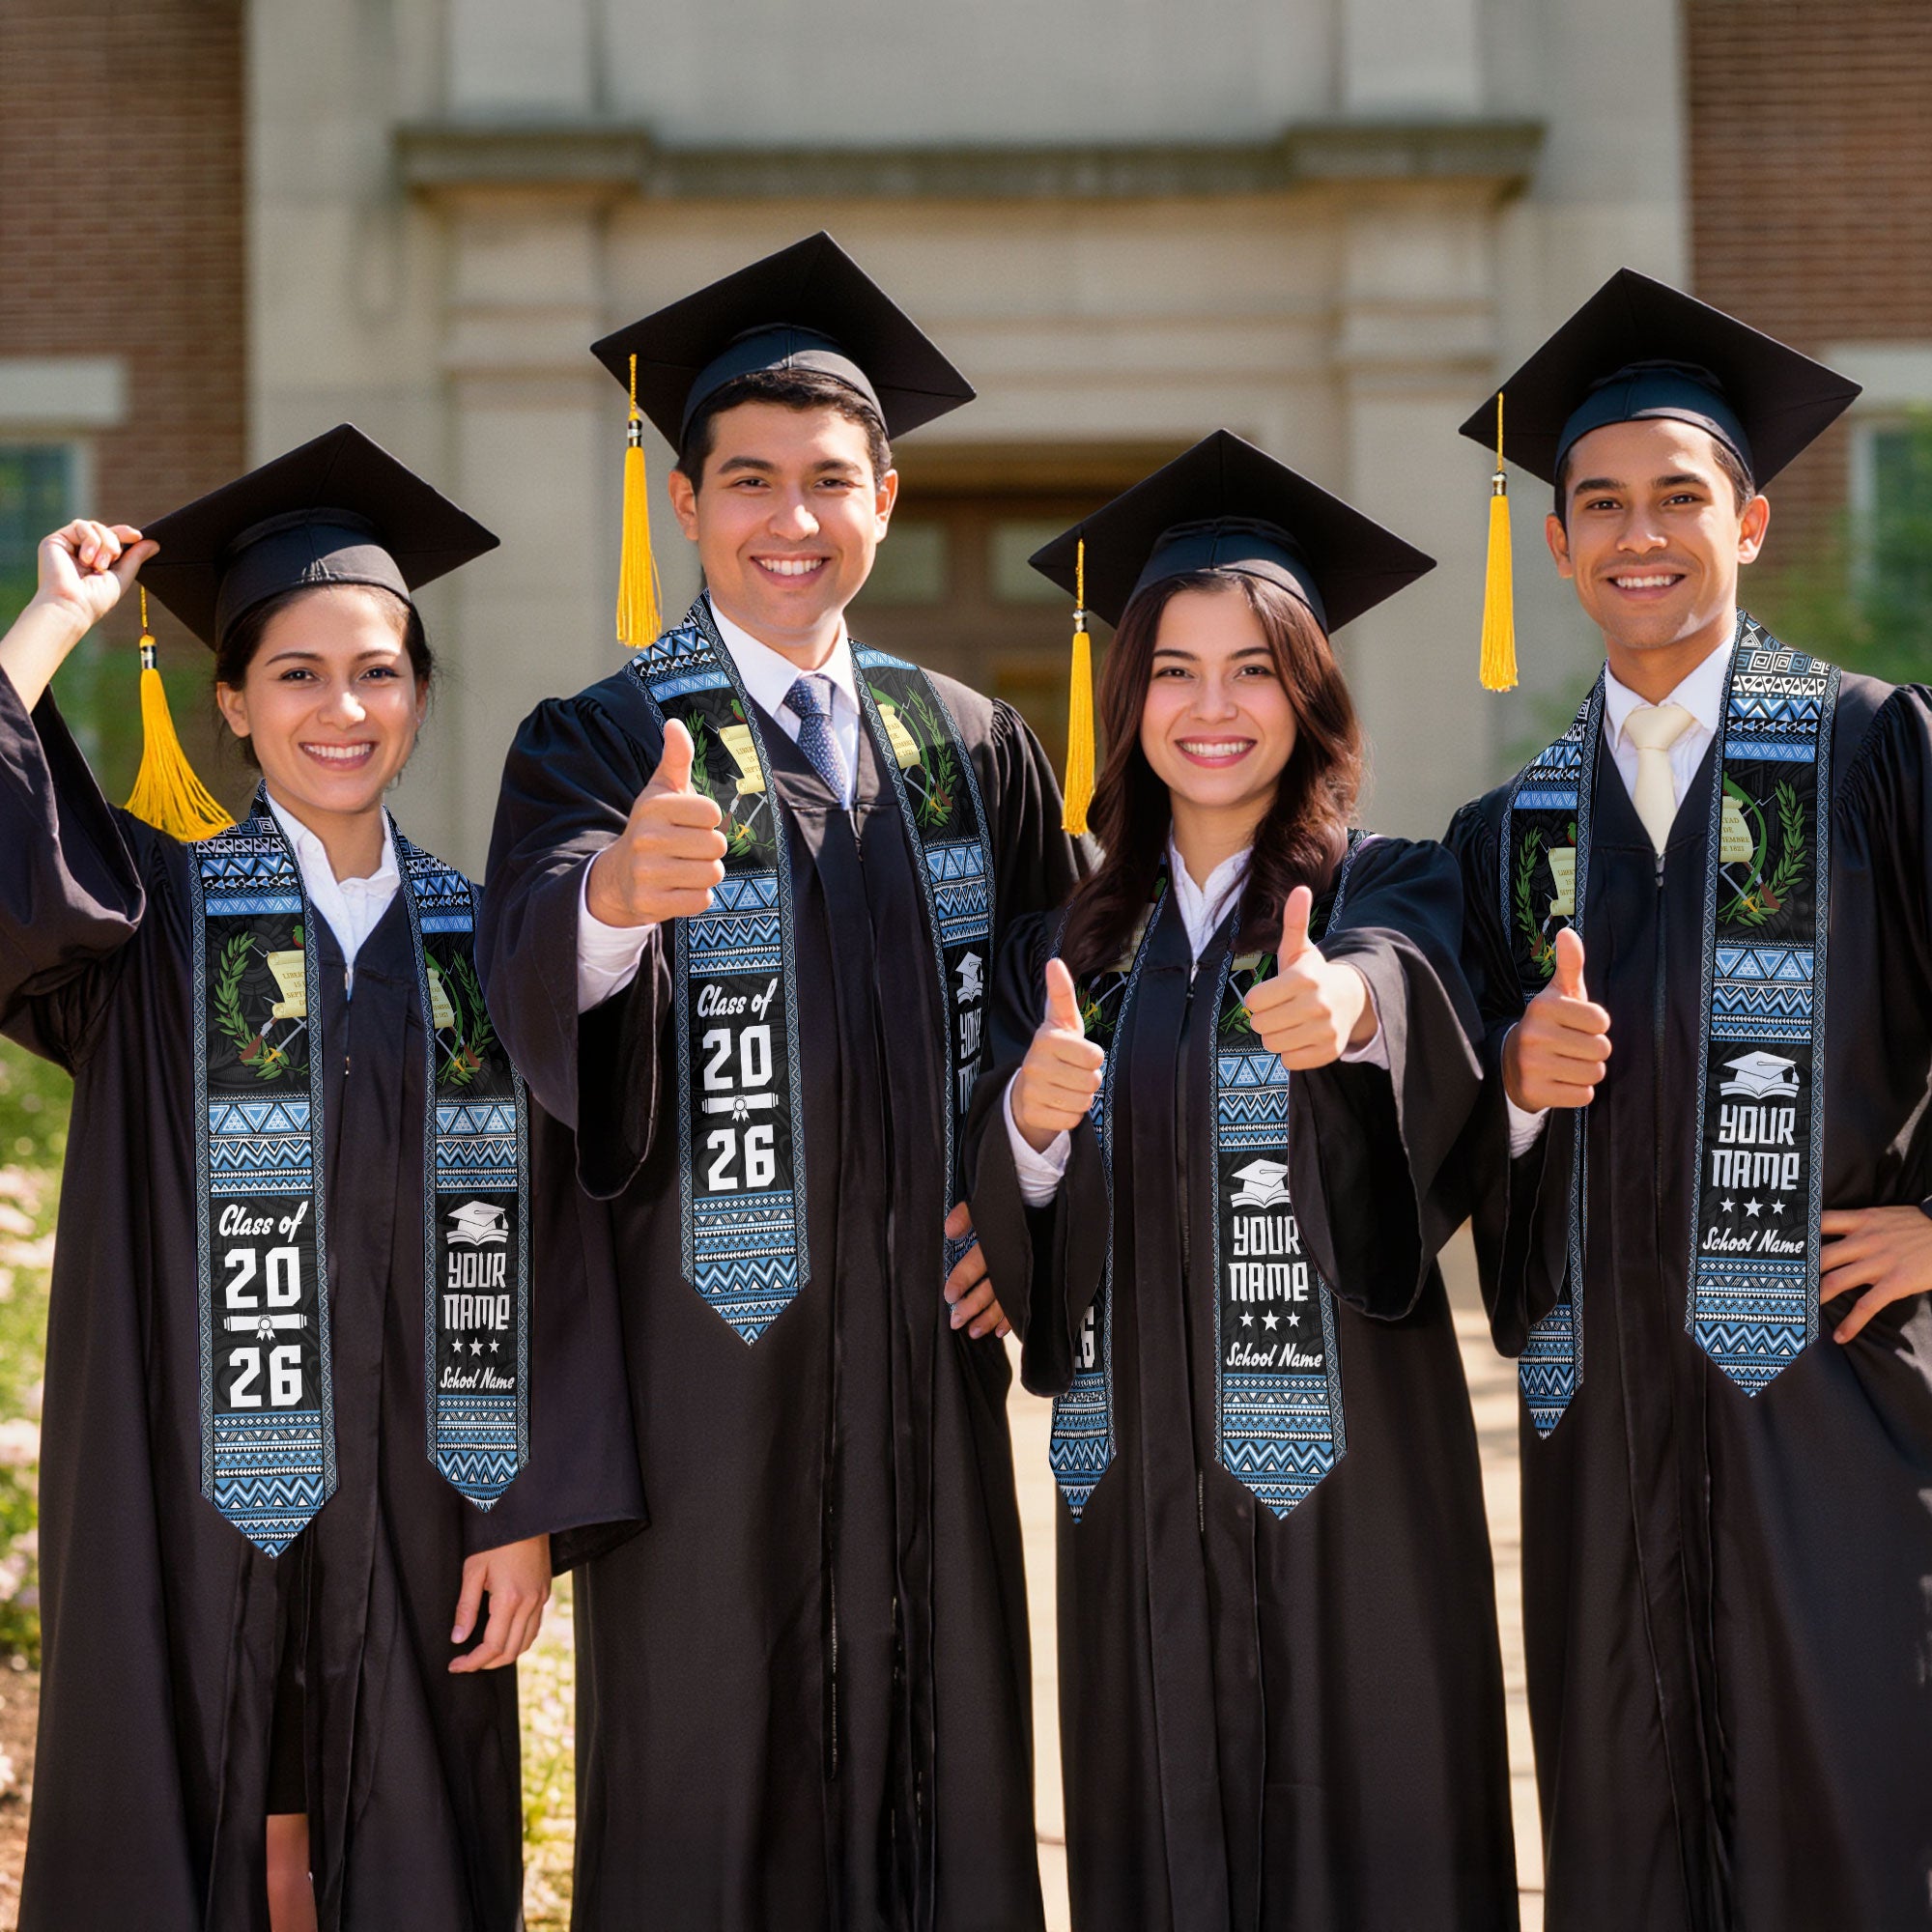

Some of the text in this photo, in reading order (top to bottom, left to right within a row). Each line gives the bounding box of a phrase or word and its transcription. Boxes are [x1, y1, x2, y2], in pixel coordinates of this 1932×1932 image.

[697, 977, 778, 1021] Class of
[703, 1025, 773, 1092] 20
[1719, 1104, 1796, 1146] YOUR
[707, 1123, 776, 1192] 26
[1711, 1149, 1800, 1191] NAME
[218, 1201, 309, 1243] Class of
[1233, 1214, 1302, 1257] YOUR
[1702, 1226, 1805, 1254] School Name
[224, 1247, 300, 1310] 20
[447, 1251, 507, 1289] YOUR
[1228, 1262, 1309, 1303] NAME
[442, 1293, 510, 1331] NAME
[1075, 1305, 1095, 1368] 6
[1226, 1341, 1323, 1369] School Name
[229, 1345, 303, 1408] 26
[440, 1366, 515, 1390] School Name
